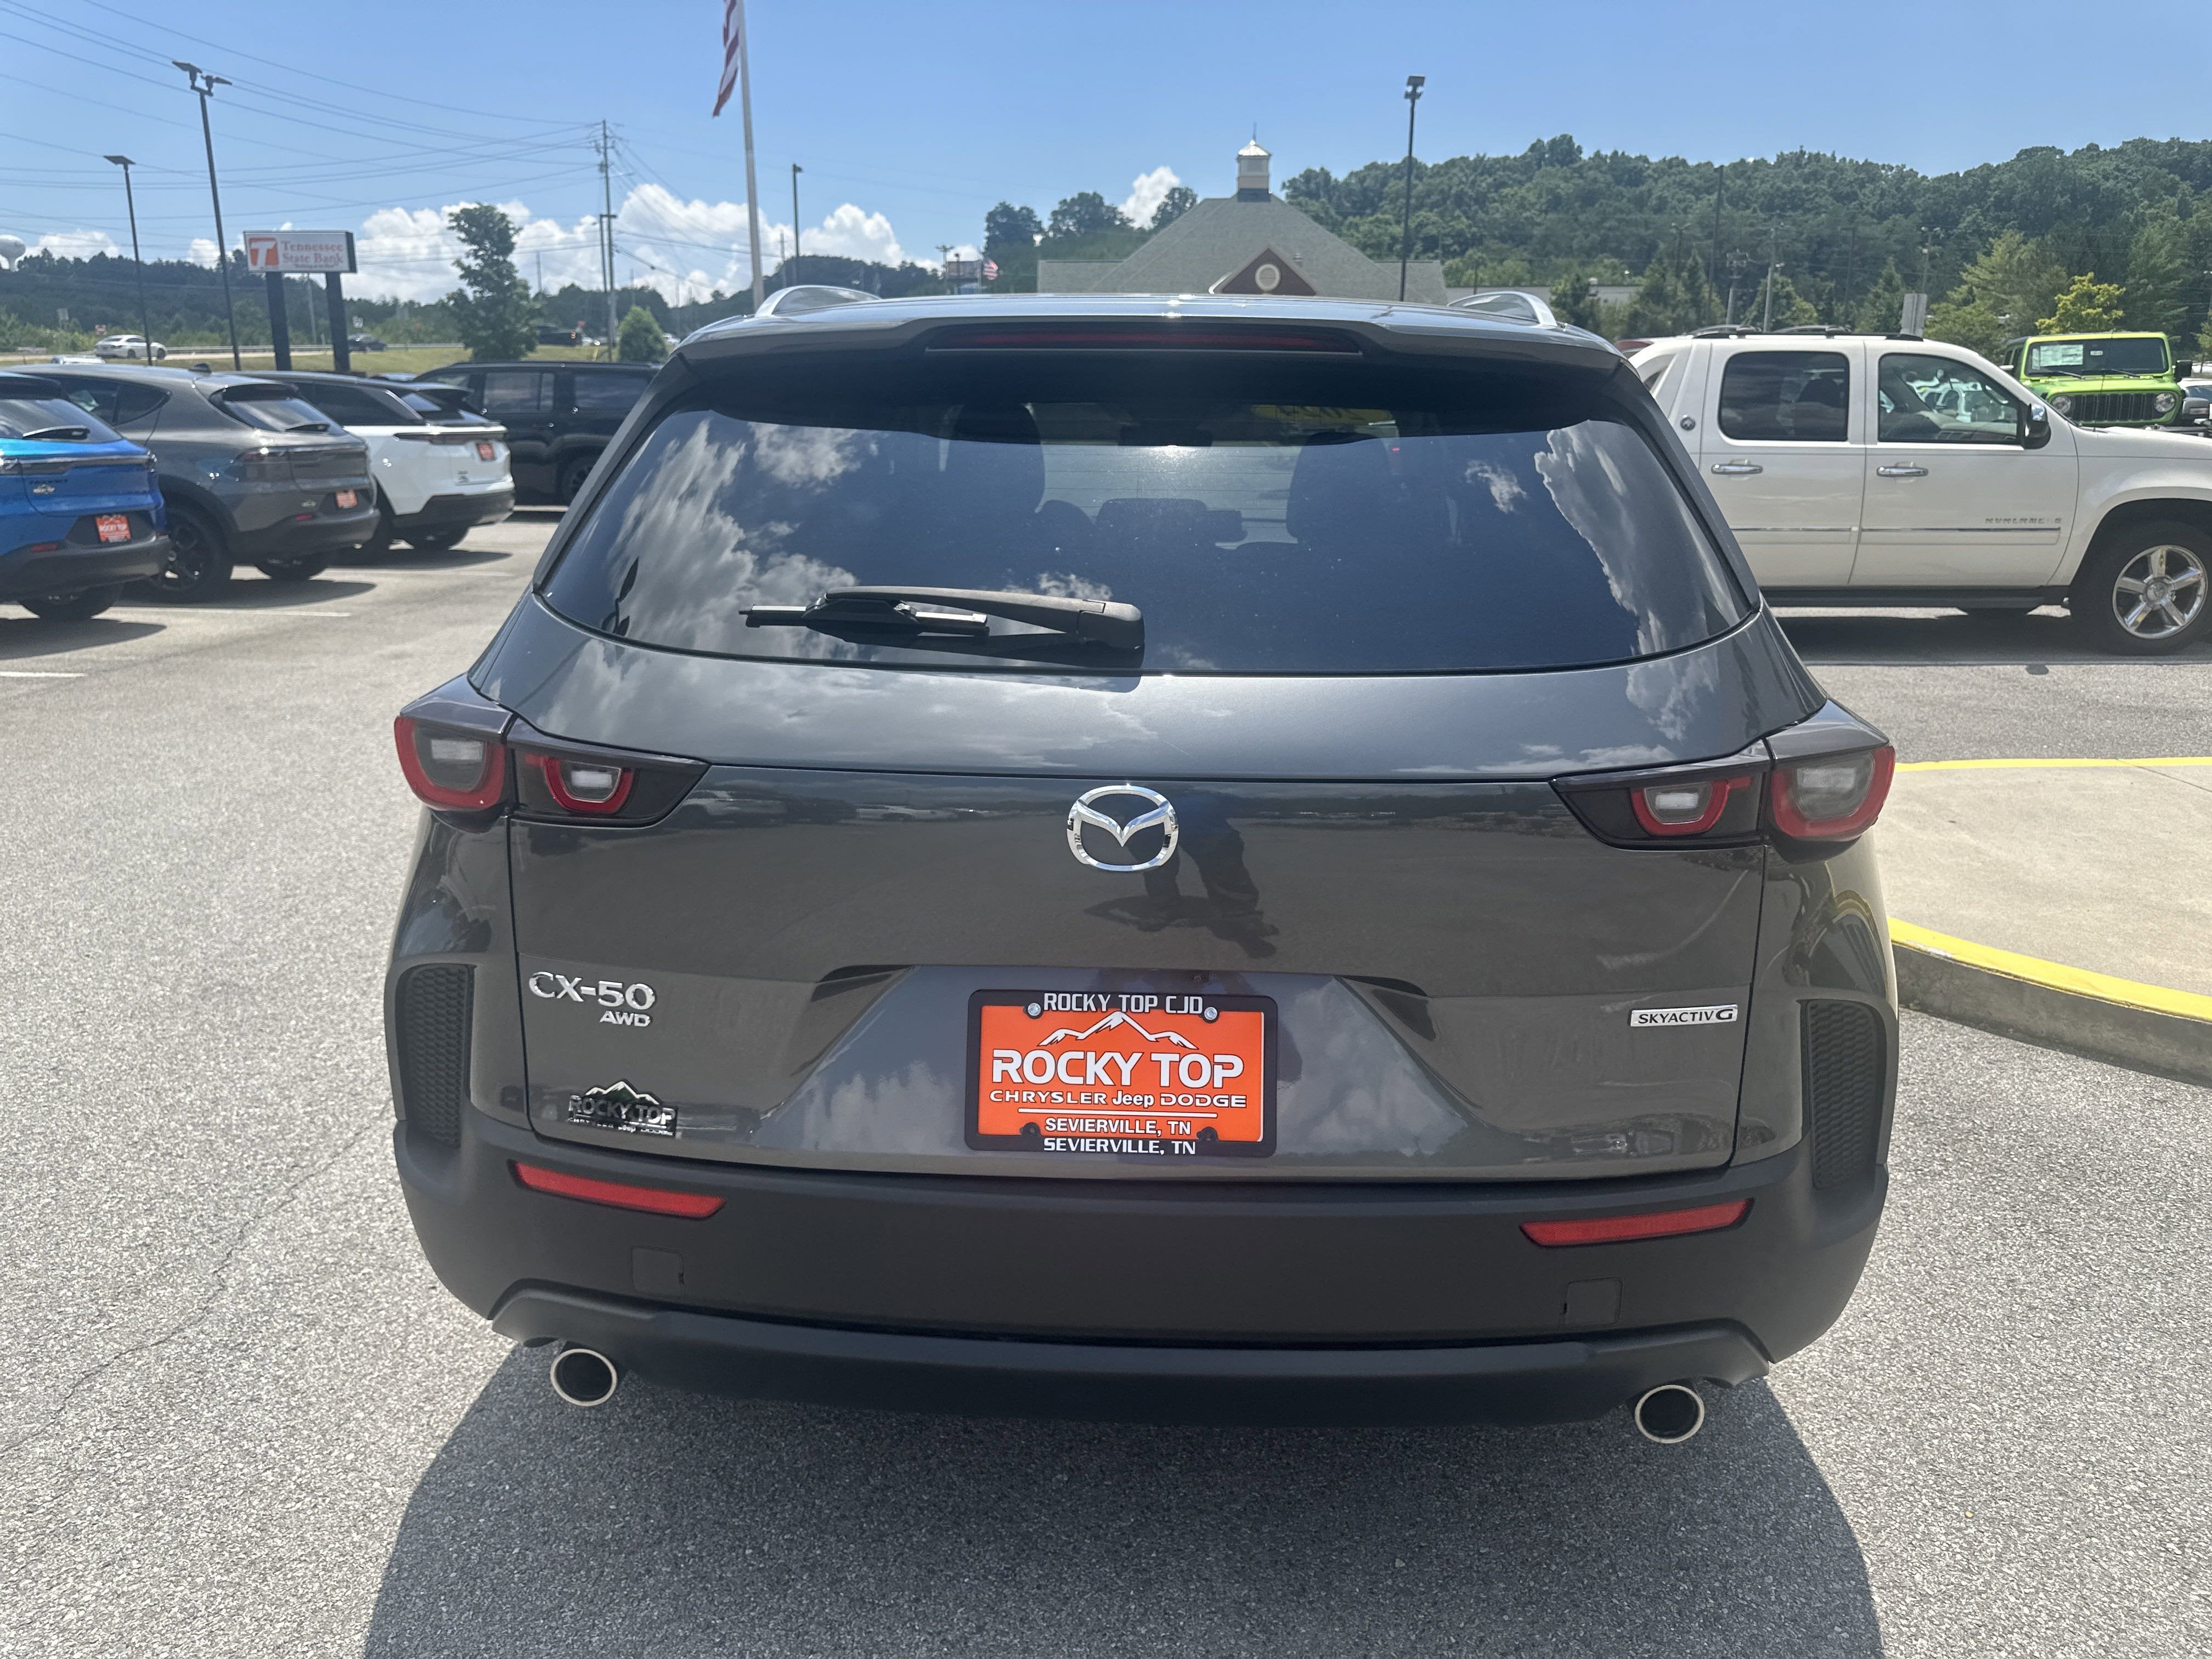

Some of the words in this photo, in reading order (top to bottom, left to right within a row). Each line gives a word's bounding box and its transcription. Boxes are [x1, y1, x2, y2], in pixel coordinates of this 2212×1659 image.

[281, 240, 343, 252] Tennessee
[282, 252, 310, 263] State
[314, 253, 343, 263] Bank
[529, 971, 655, 1010] CX-50
[1043, 993, 1111, 1013] ROCKY
[1118, 994, 1158, 1013] TOP
[1165, 996, 1203, 1015] CJD
[600, 1011, 651, 1027] AWD
[991, 1049, 1144, 1087] ROCKY
[1150, 1052, 1244, 1088] TOP
[990, 1090, 1108, 1105] CHRYSLER
[1111, 1090, 1155, 1109] Jeep
[1160, 1094, 1247, 1108] DODGE
[568, 1094, 631, 1120] ROCKY
[635, 1104, 676, 1125] TOP
[1045, 1118, 1162, 1137] SEVIERVILLE,
[1167, 1121, 1191, 1135] TN
[1043, 1138, 1165, 1154] SEVIERVILLE,
[1170, 1139, 1196, 1155] TN
